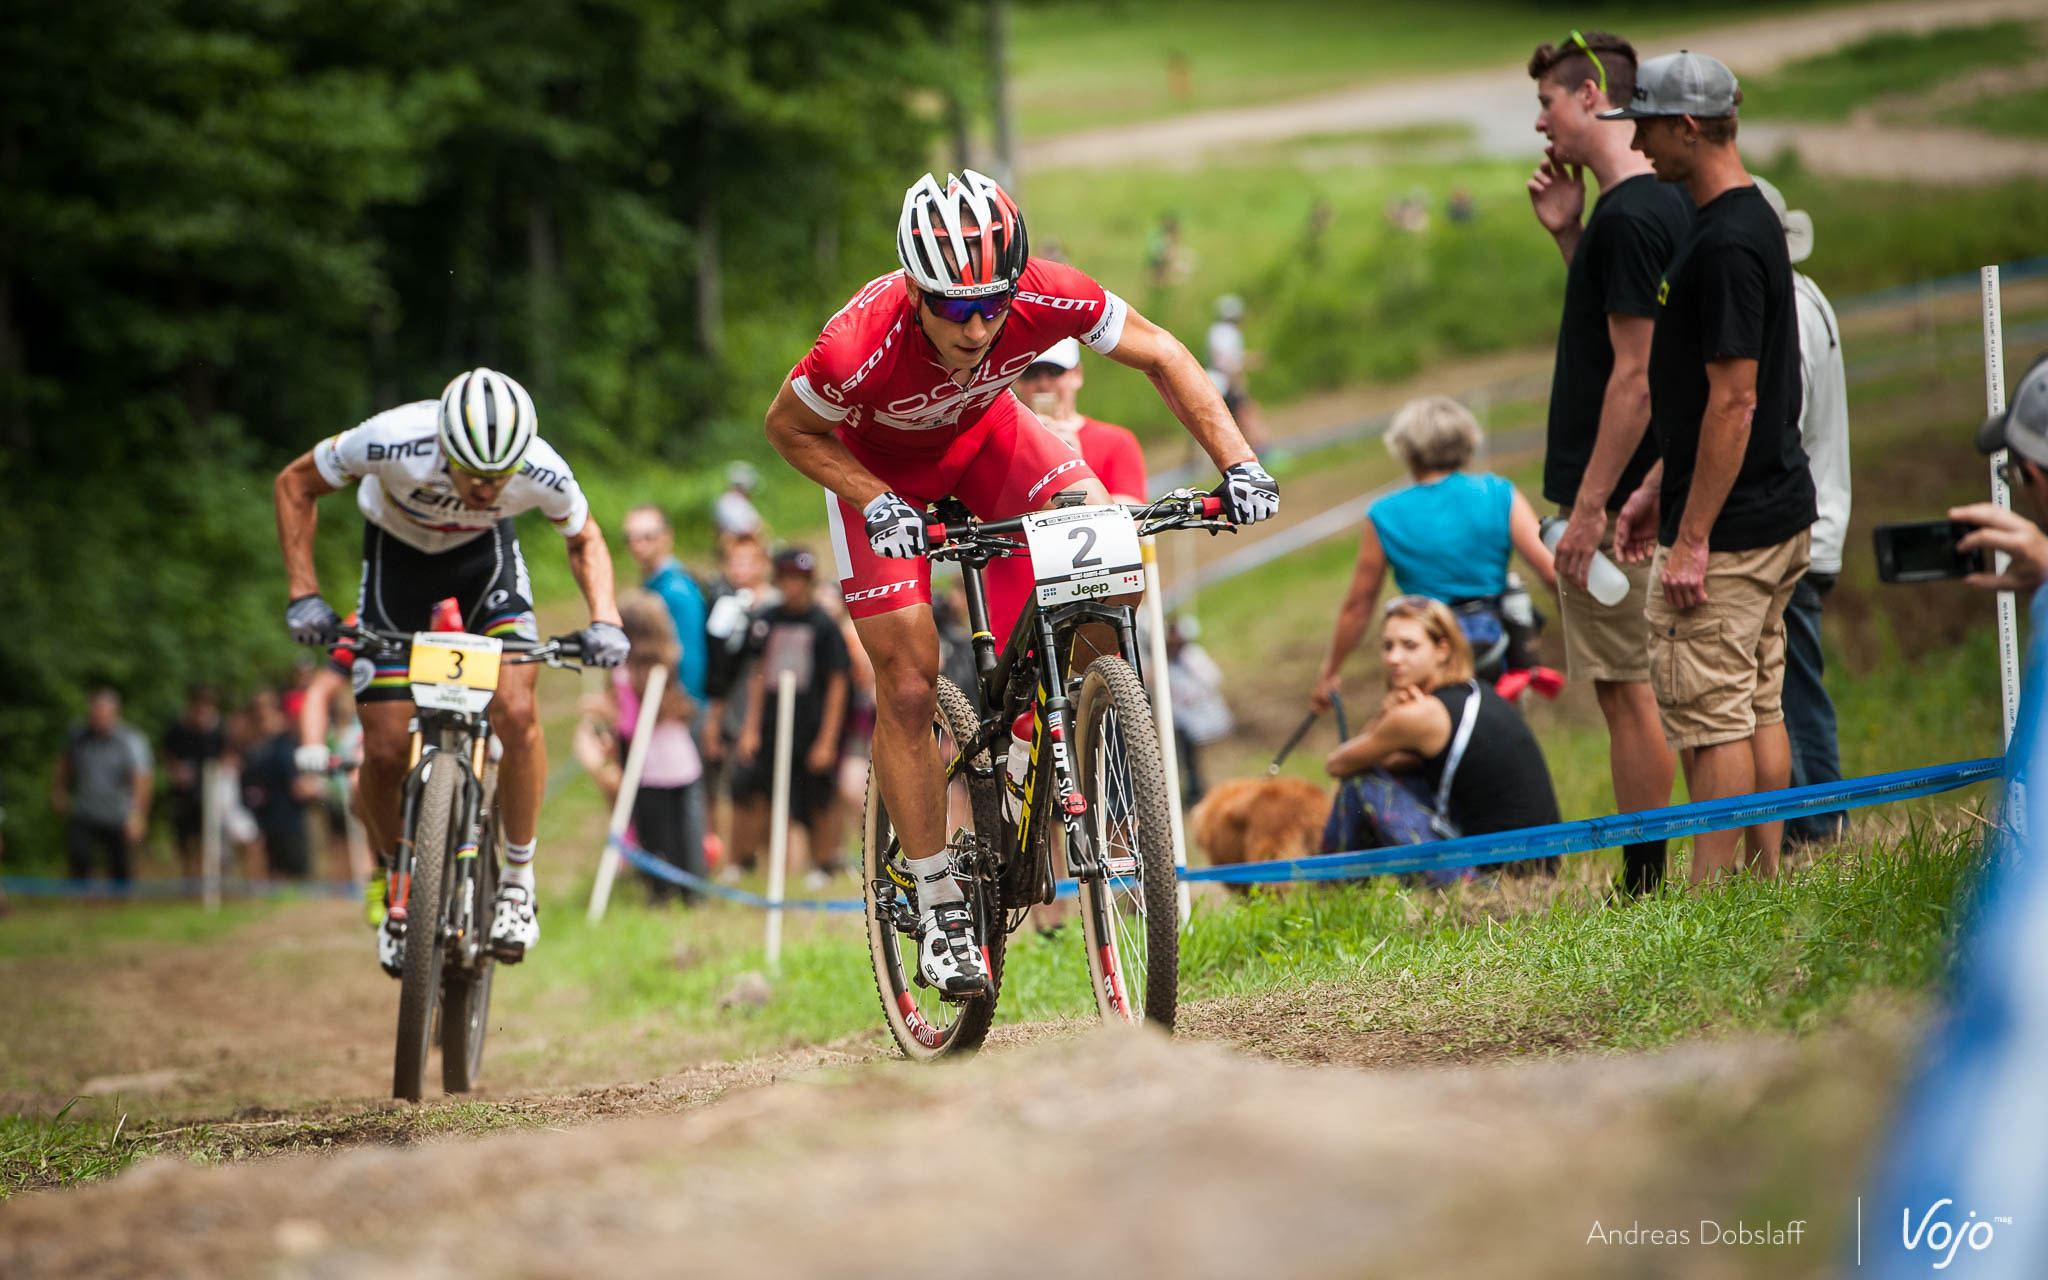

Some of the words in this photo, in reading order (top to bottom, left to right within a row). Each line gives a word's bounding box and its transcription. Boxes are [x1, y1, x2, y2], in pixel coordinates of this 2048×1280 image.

[946, 281, 1007, 296] cornercard
[1015, 291, 1100, 311] SCOTT
[841, 314, 904, 393] SCOTT
[367, 440, 436, 461] BMC
[1067, 526, 1103, 569] 2
[845, 579, 919, 603] SCOTT
[1071, 582, 1110, 596] Jeep
[447, 650, 464, 680] 3
[1052, 742, 1071, 772] DT
[905, 1011, 920, 1032] DT
[915, 1025, 937, 1046] SWISS
